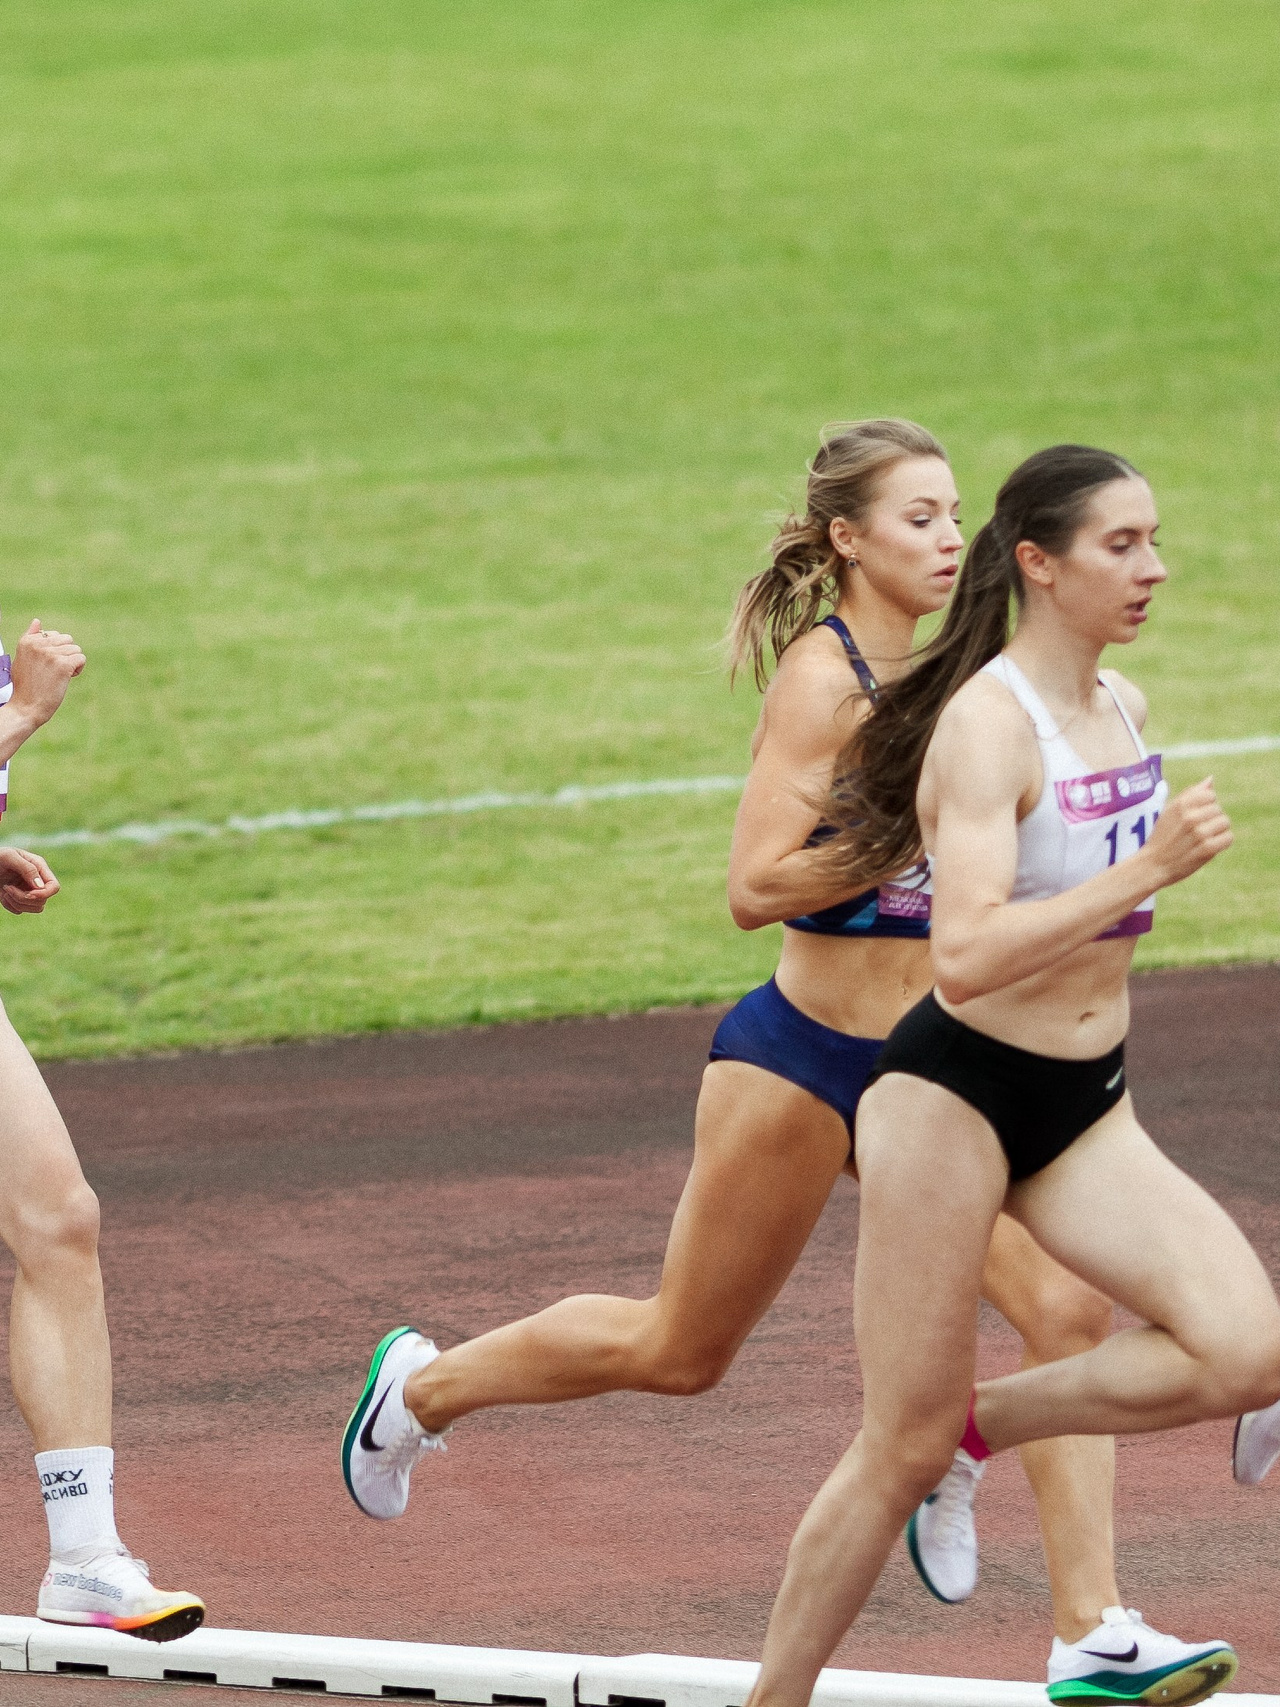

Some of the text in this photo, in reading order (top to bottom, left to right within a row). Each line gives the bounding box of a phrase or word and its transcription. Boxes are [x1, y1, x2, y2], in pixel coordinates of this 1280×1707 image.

[40, 1468, 83, 1486] ОЖУ
[53, 1573, 123, 1602] new balance
